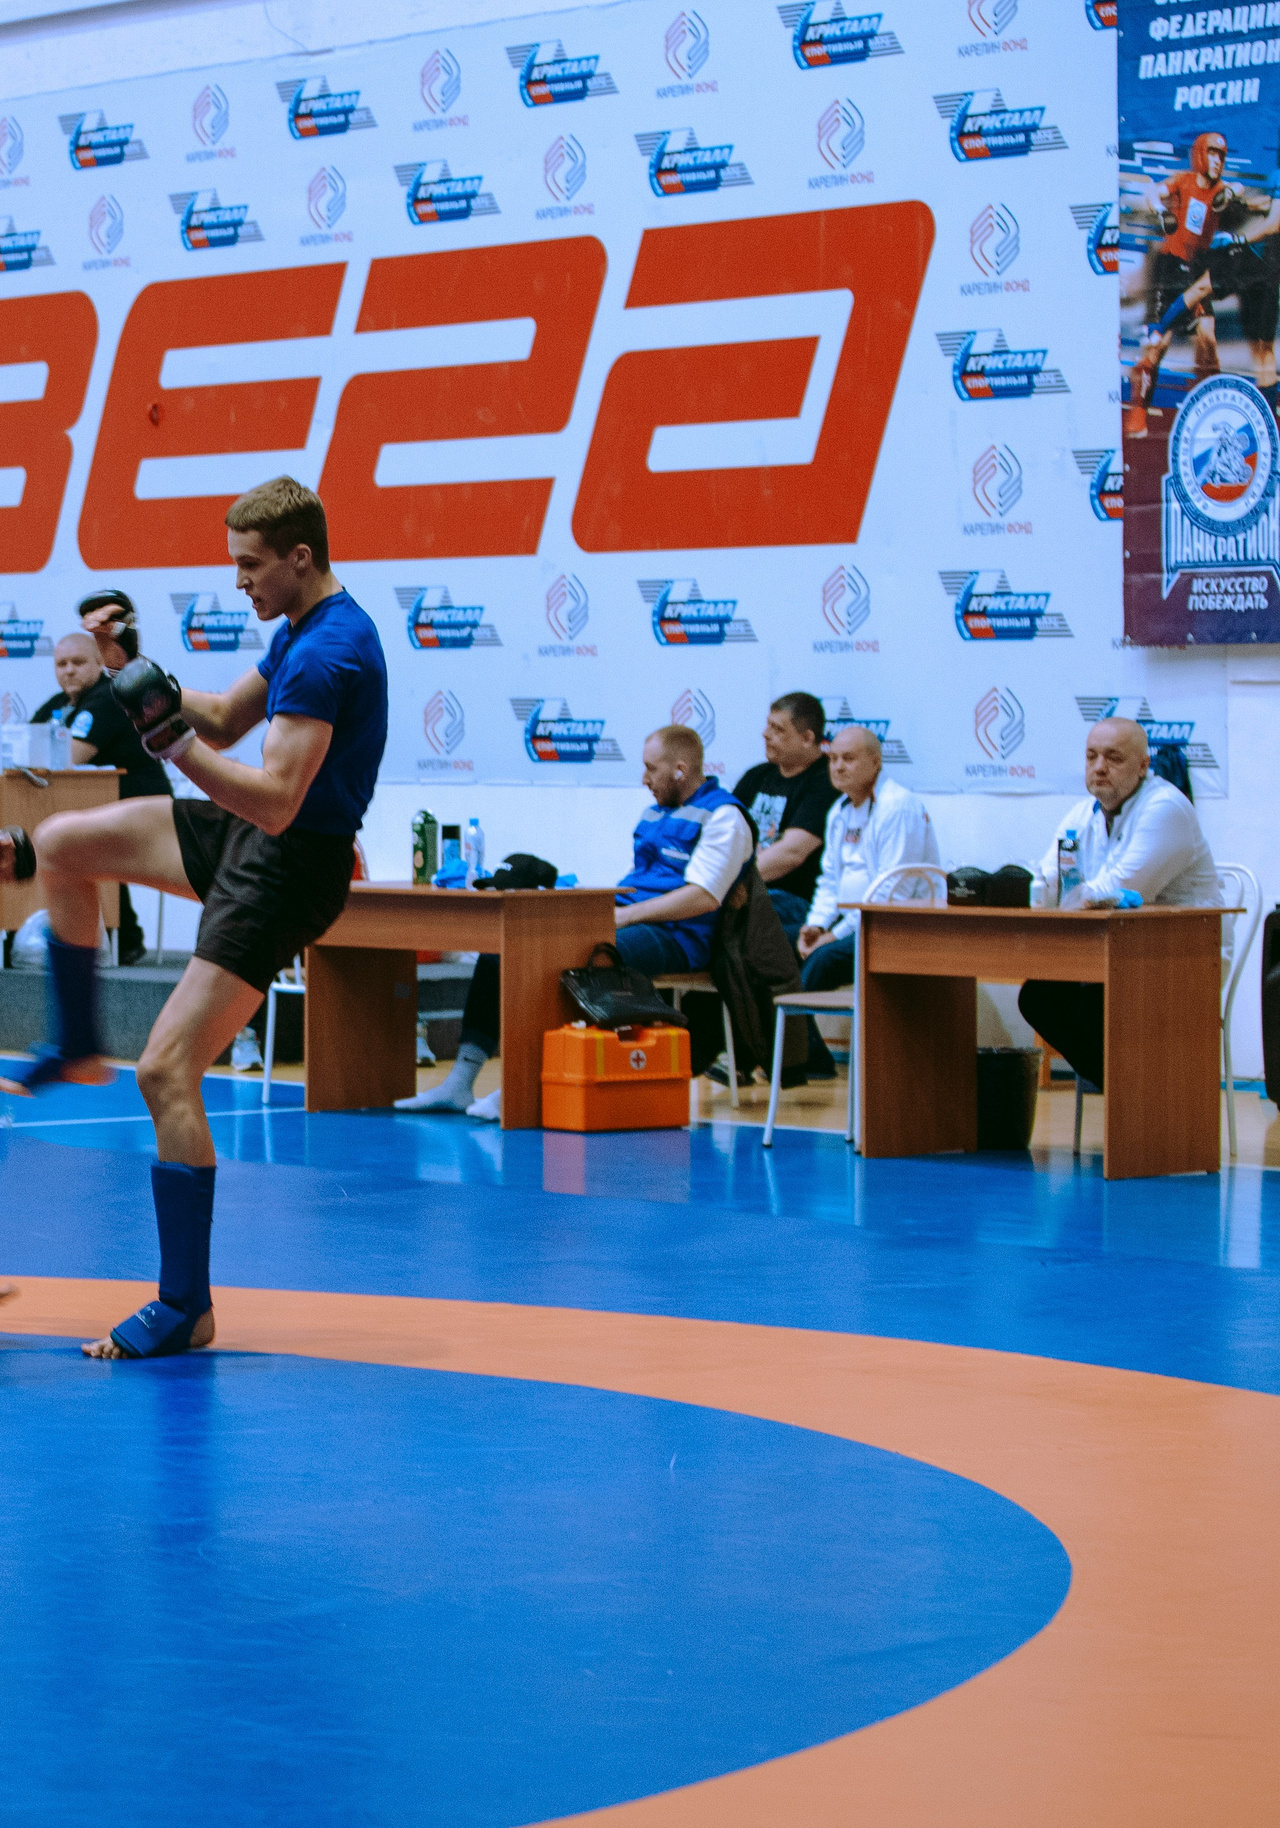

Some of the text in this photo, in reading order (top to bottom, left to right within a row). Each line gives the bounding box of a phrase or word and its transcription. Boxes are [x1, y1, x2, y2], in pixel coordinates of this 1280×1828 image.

[804, 15, 879, 41] КРИСТАЛЛ
[1149, 1, 1280, 41] ФЕДЕРАЦИИ
[530, 57, 598, 80] КРИСТАЛЛ
[1139, 38, 1280, 80] ПАНКРАТИОН
[1174, 77, 1260, 111] РОССИИ
[963, 108, 1041, 133] КРИСТАЛЛ
[661, 147, 730, 171] КРИСТАЛЛ
[966, 352, 1045, 374] КРИСТАЛЛ
[1006, 521, 1033, 535] ФОНД
[1191, 575, 1268, 594] ИСКУССТВО
[664, 602, 736, 619] КРИСТАЛЛ
[968, 593, 1048, 613] КРИСТАЛЛ
[1187, 593, 1268, 613] ПОБЕЖДАТЬ
[535, 720, 603, 739] КРИСТАЛЛ
[1009, 765, 1036, 779] ФОНД
